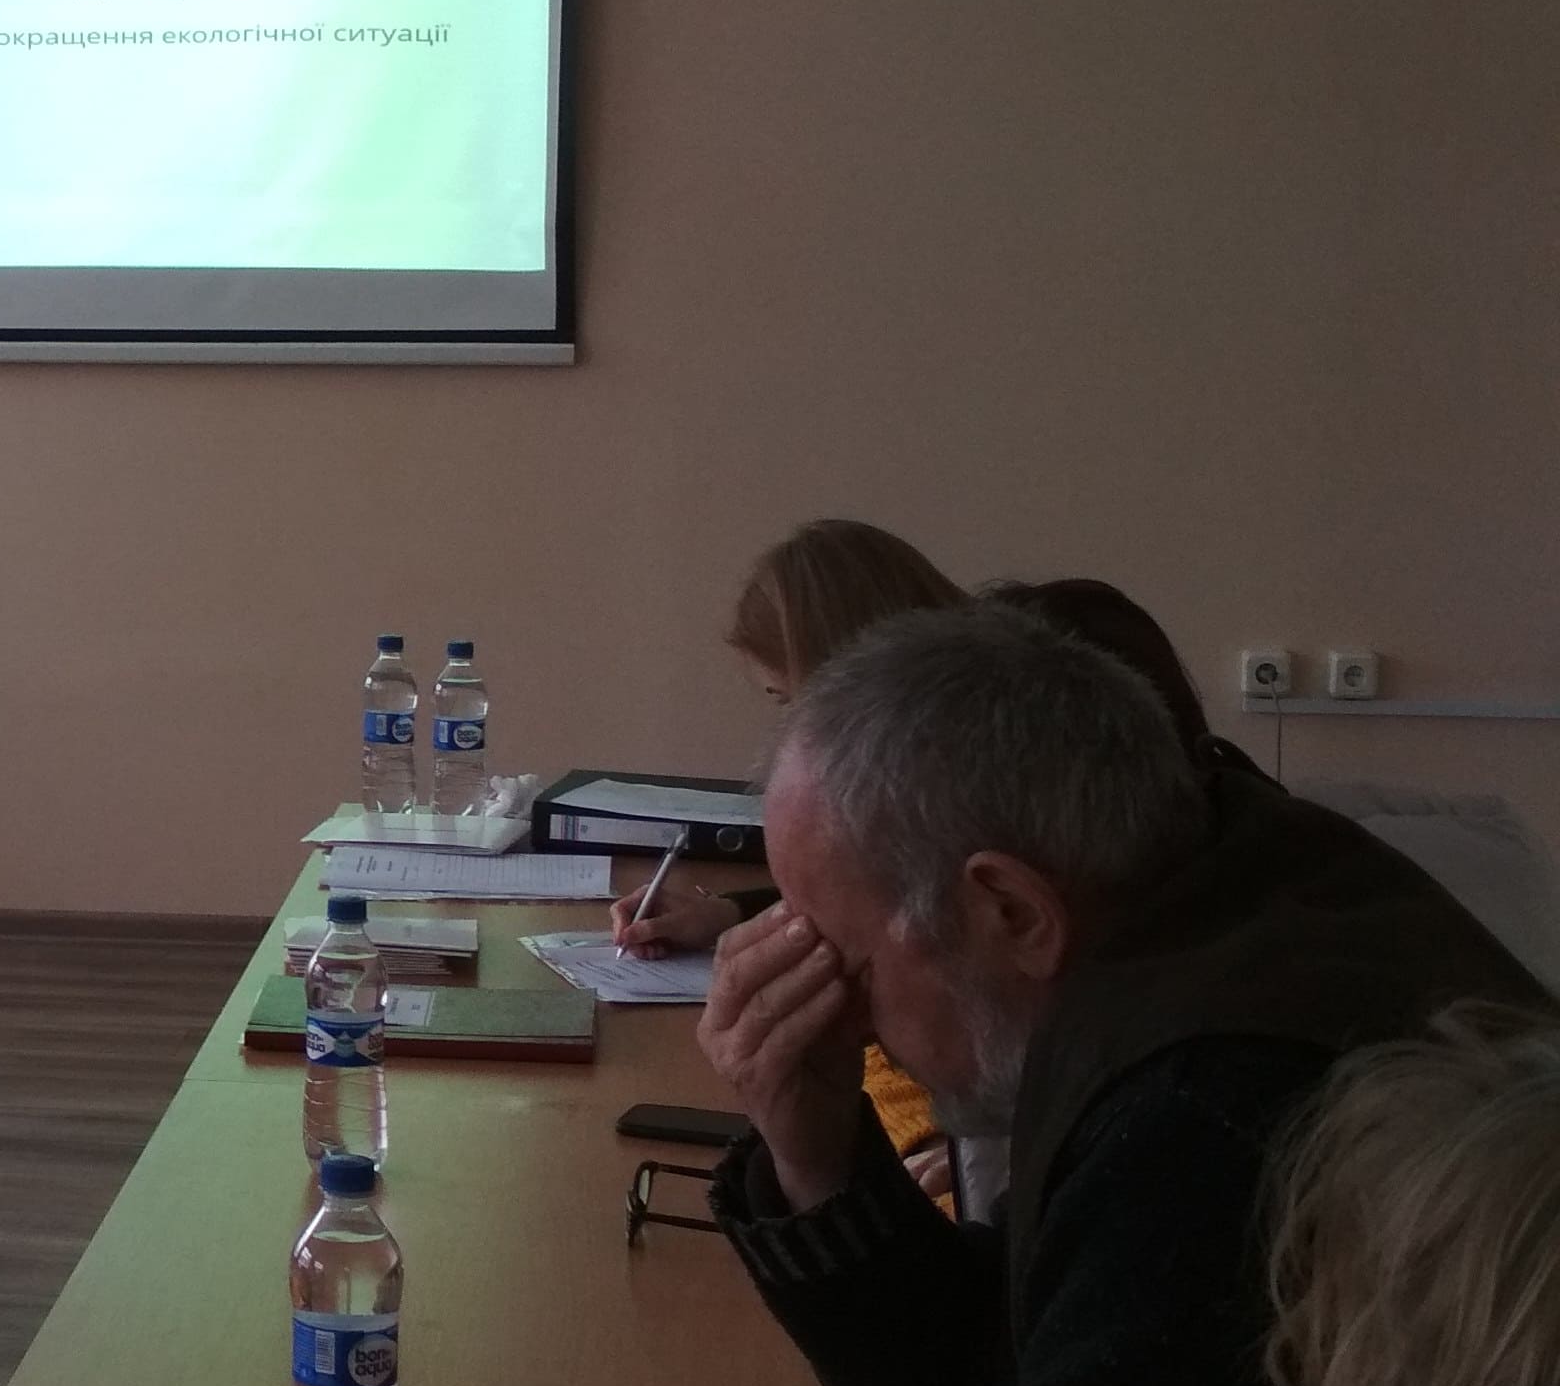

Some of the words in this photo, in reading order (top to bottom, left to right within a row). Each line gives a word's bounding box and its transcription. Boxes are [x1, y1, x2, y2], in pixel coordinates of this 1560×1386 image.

[161, 22, 325, 45] екологічної
[333, 23, 452, 48] ситуації
[355, 1359, 393, 1378] aqua
